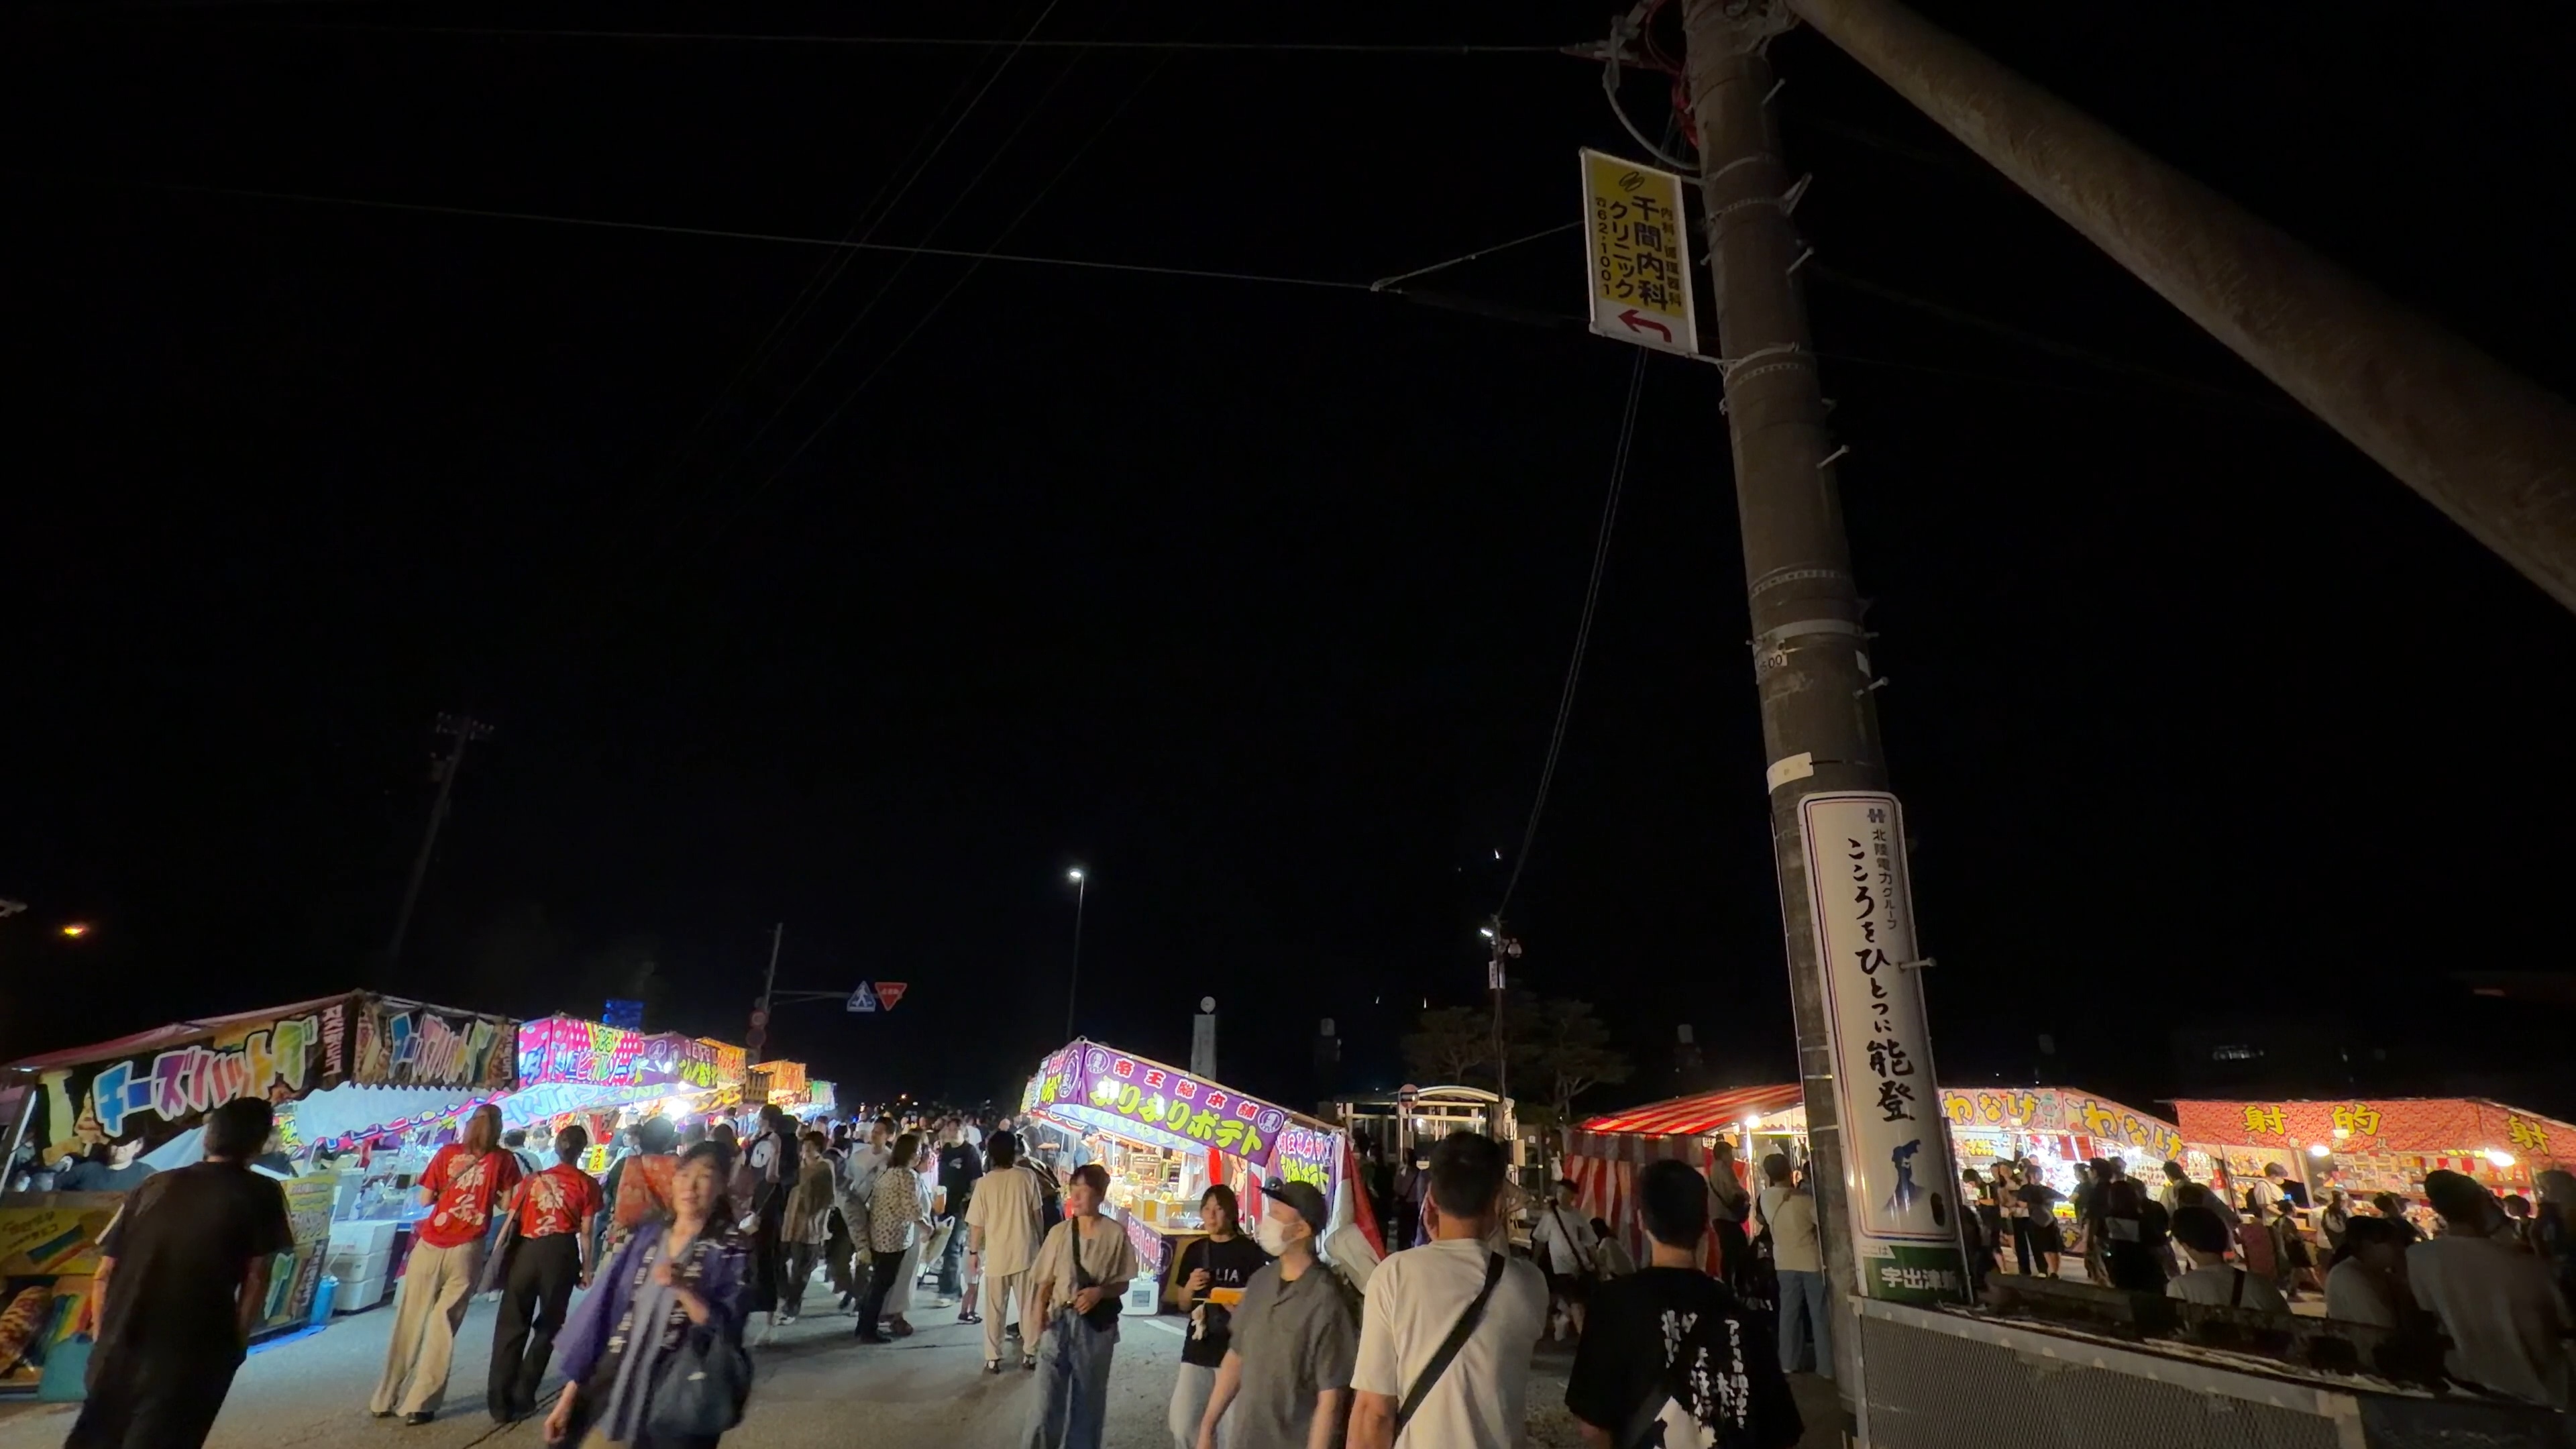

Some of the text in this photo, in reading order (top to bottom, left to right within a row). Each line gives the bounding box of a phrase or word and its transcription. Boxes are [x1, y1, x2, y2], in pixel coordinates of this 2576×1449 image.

[1610, 201, 1634, 299] クリニック
[1872, 828, 1898, 930] 北陸電力グループ
[1943, 1089, 2038, 1126] わなげ
[2081, 1099, 2185, 1161] わなげ
[2243, 1104, 2381, 1136] 射的
[2508, 1114, 2550, 1157] 射
